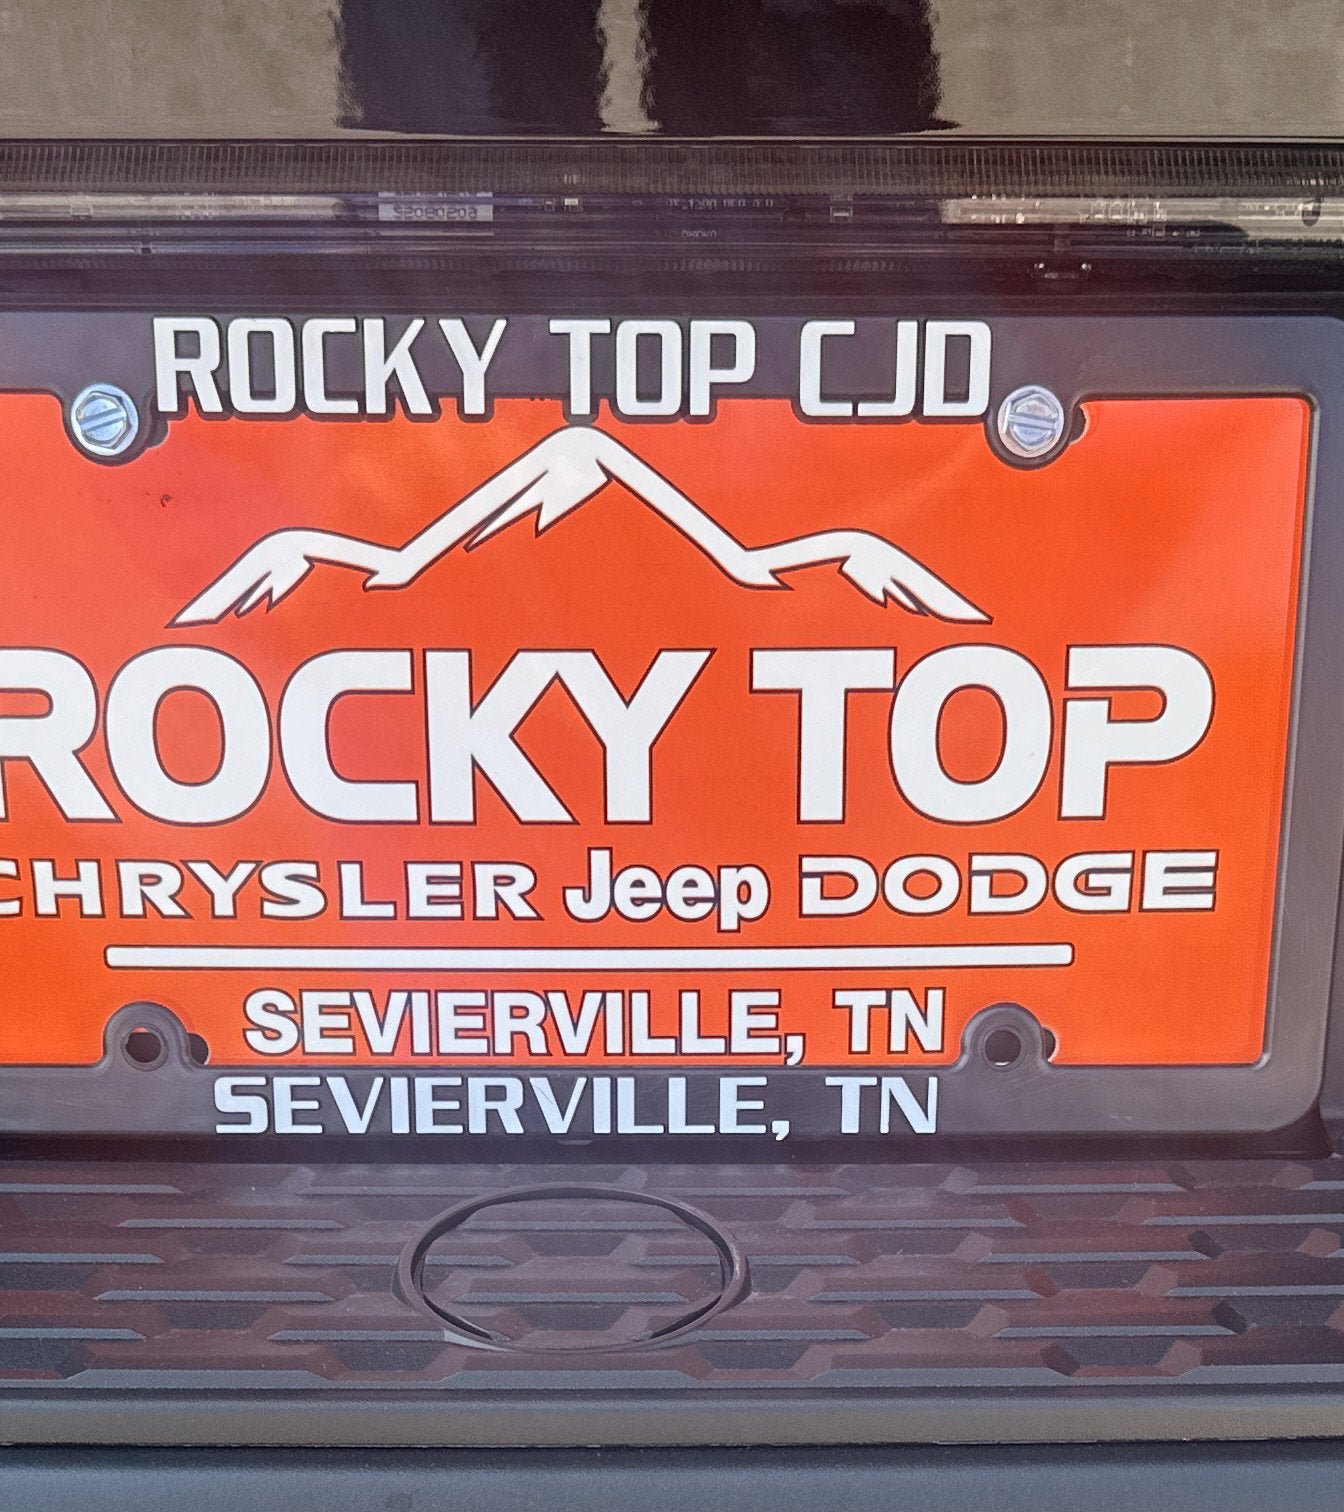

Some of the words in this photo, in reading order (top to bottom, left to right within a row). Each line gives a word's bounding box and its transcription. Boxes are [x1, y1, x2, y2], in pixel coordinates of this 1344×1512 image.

[151, 316, 508, 416] ROCKY
[548, 318, 757, 417] TOP
[798, 319, 993, 418] CJD
[750, 644, 1215, 823] TOP
[564, 849, 770, 931] Jeep
[800, 851, 1218, 916] DODGE
[244, 989, 805, 1067] SEVIERVILLE,
[834, 989, 944, 1055] TN
[213, 1075, 791, 1142] SEVIERVILLE,
[824, 1075, 939, 1135] TN
